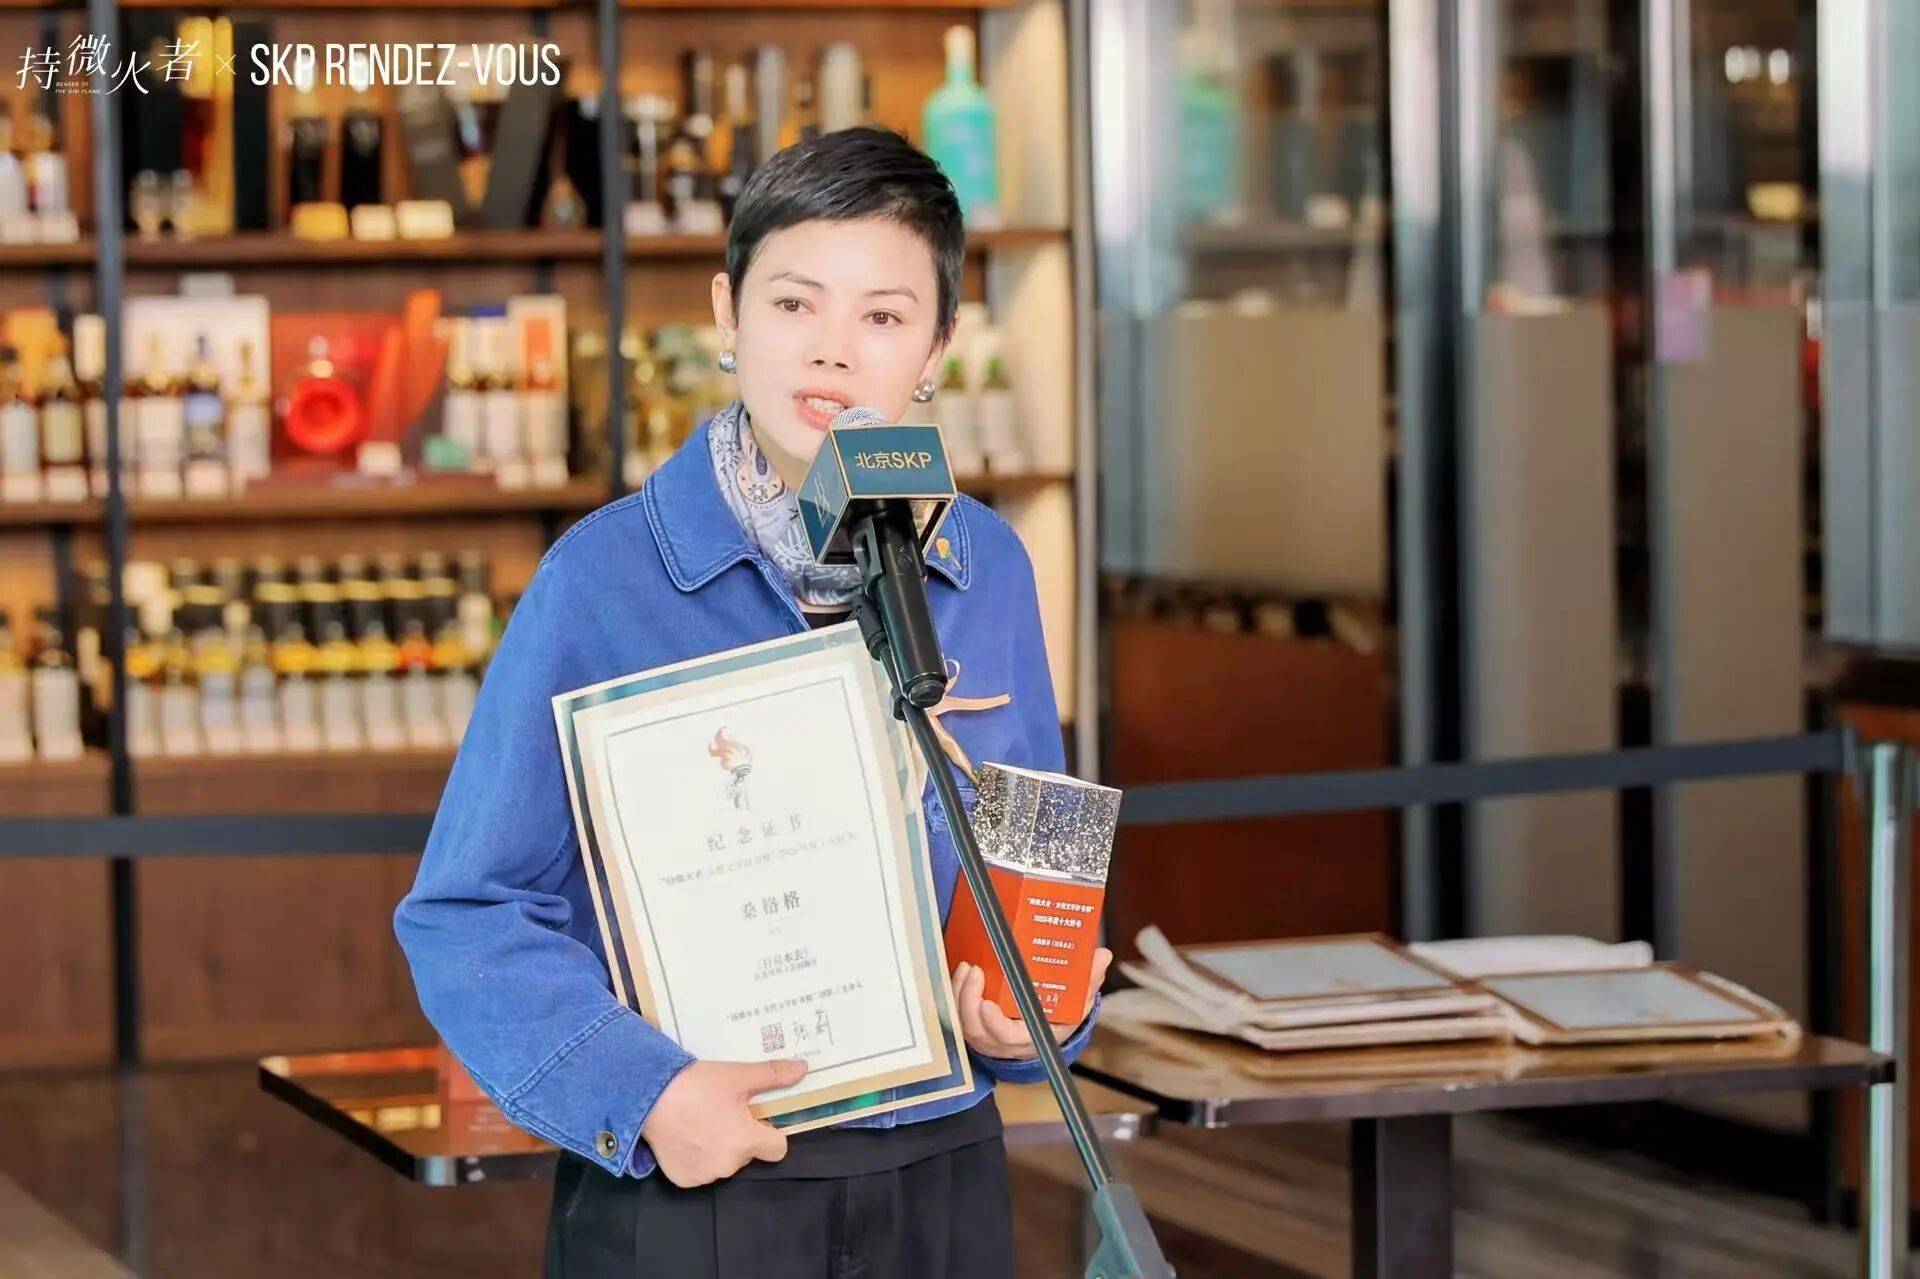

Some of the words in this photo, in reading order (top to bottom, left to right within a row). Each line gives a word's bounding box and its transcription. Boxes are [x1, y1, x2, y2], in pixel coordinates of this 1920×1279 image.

[854, 452, 932, 469] 北京SKP
[707, 813, 802, 852] 纪念证书
[743, 890, 801, 919] 桑格格
